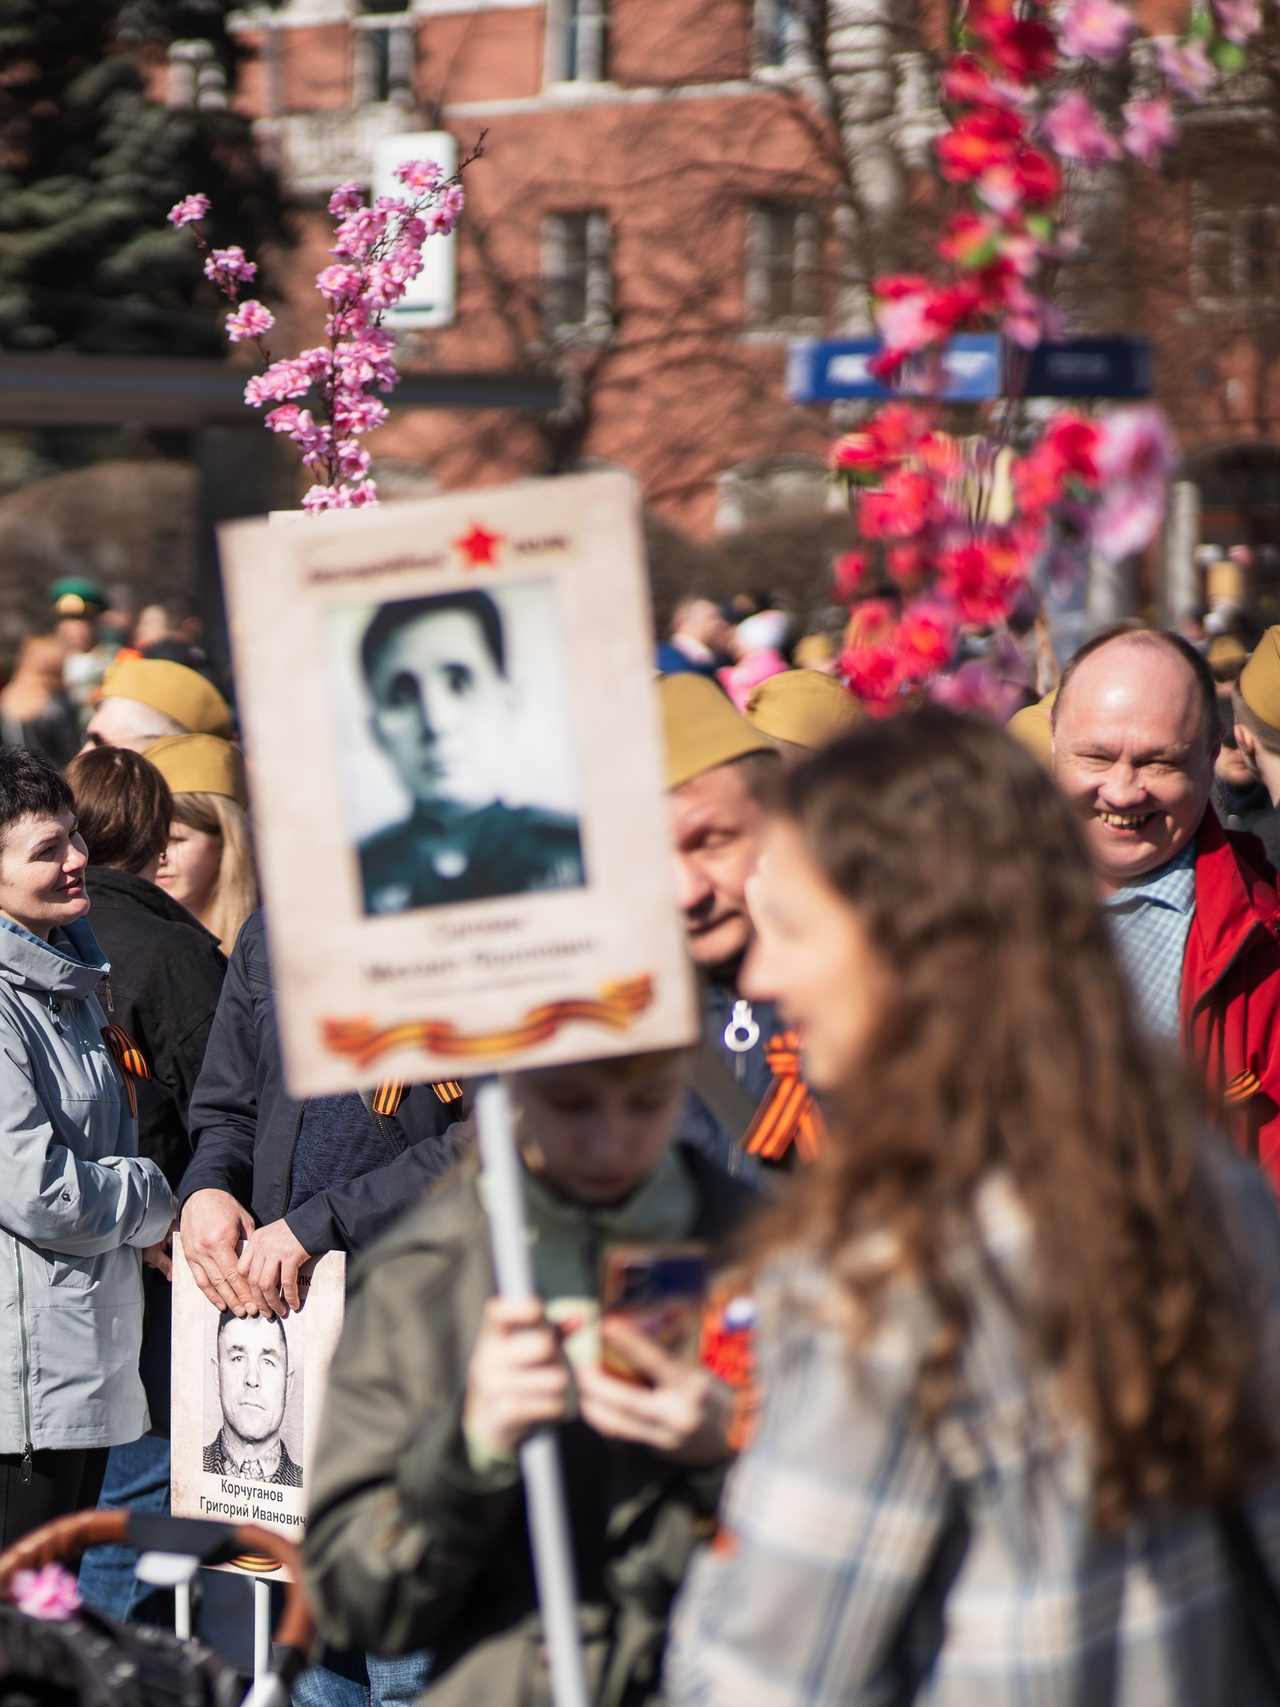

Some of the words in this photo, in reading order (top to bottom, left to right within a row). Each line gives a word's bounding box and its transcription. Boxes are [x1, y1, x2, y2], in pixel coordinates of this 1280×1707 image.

[221, 1478, 284, 1502] Корчуганов
[200, 1496, 249, 1518] Григорий
[252, 1505, 307, 1527] Иванович
